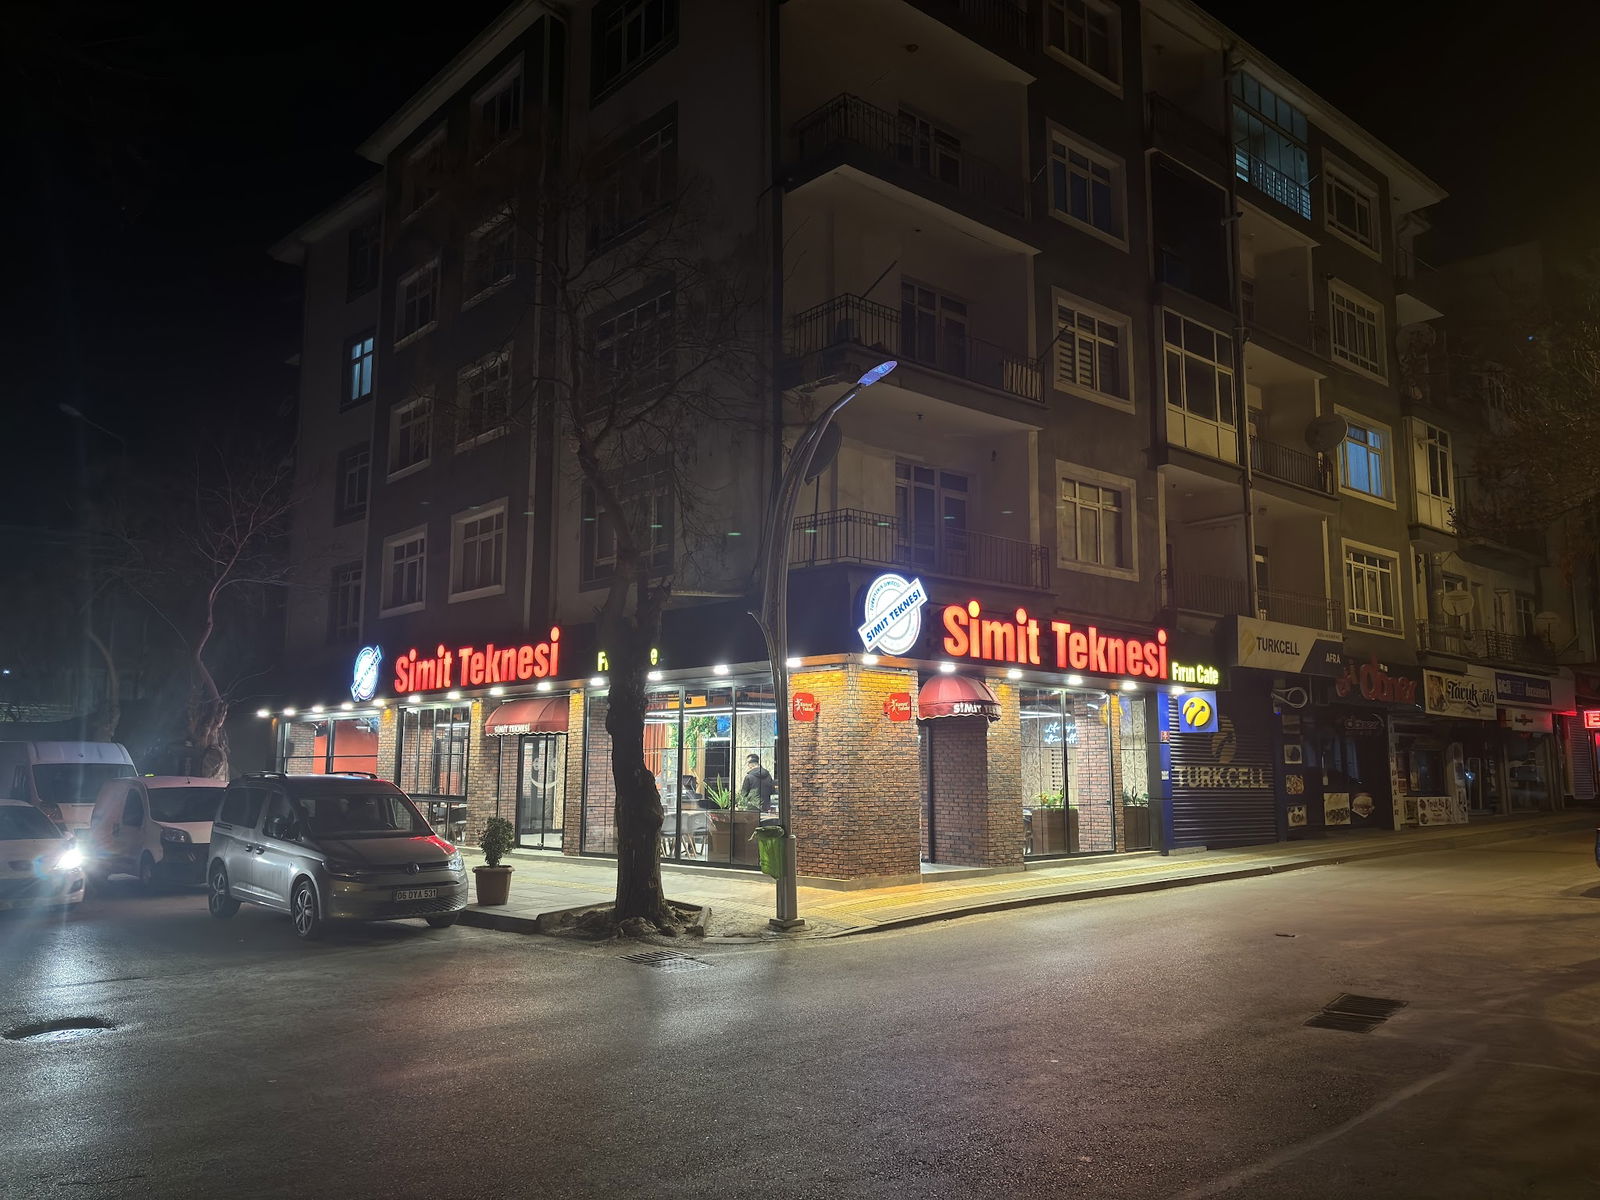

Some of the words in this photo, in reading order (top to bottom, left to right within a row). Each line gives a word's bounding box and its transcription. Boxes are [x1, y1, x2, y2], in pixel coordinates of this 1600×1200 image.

[942, 599, 1041, 666] Simit
[1051, 621, 1169, 680] Teknesi
[1256, 636, 1300, 656] TURKCELL
[394, 643, 452, 694] Simit
[458, 625, 561, 687] Teknesi
[1325, 652, 1342, 665] AFRA
[1196, 664, 1219, 685] Cafe
